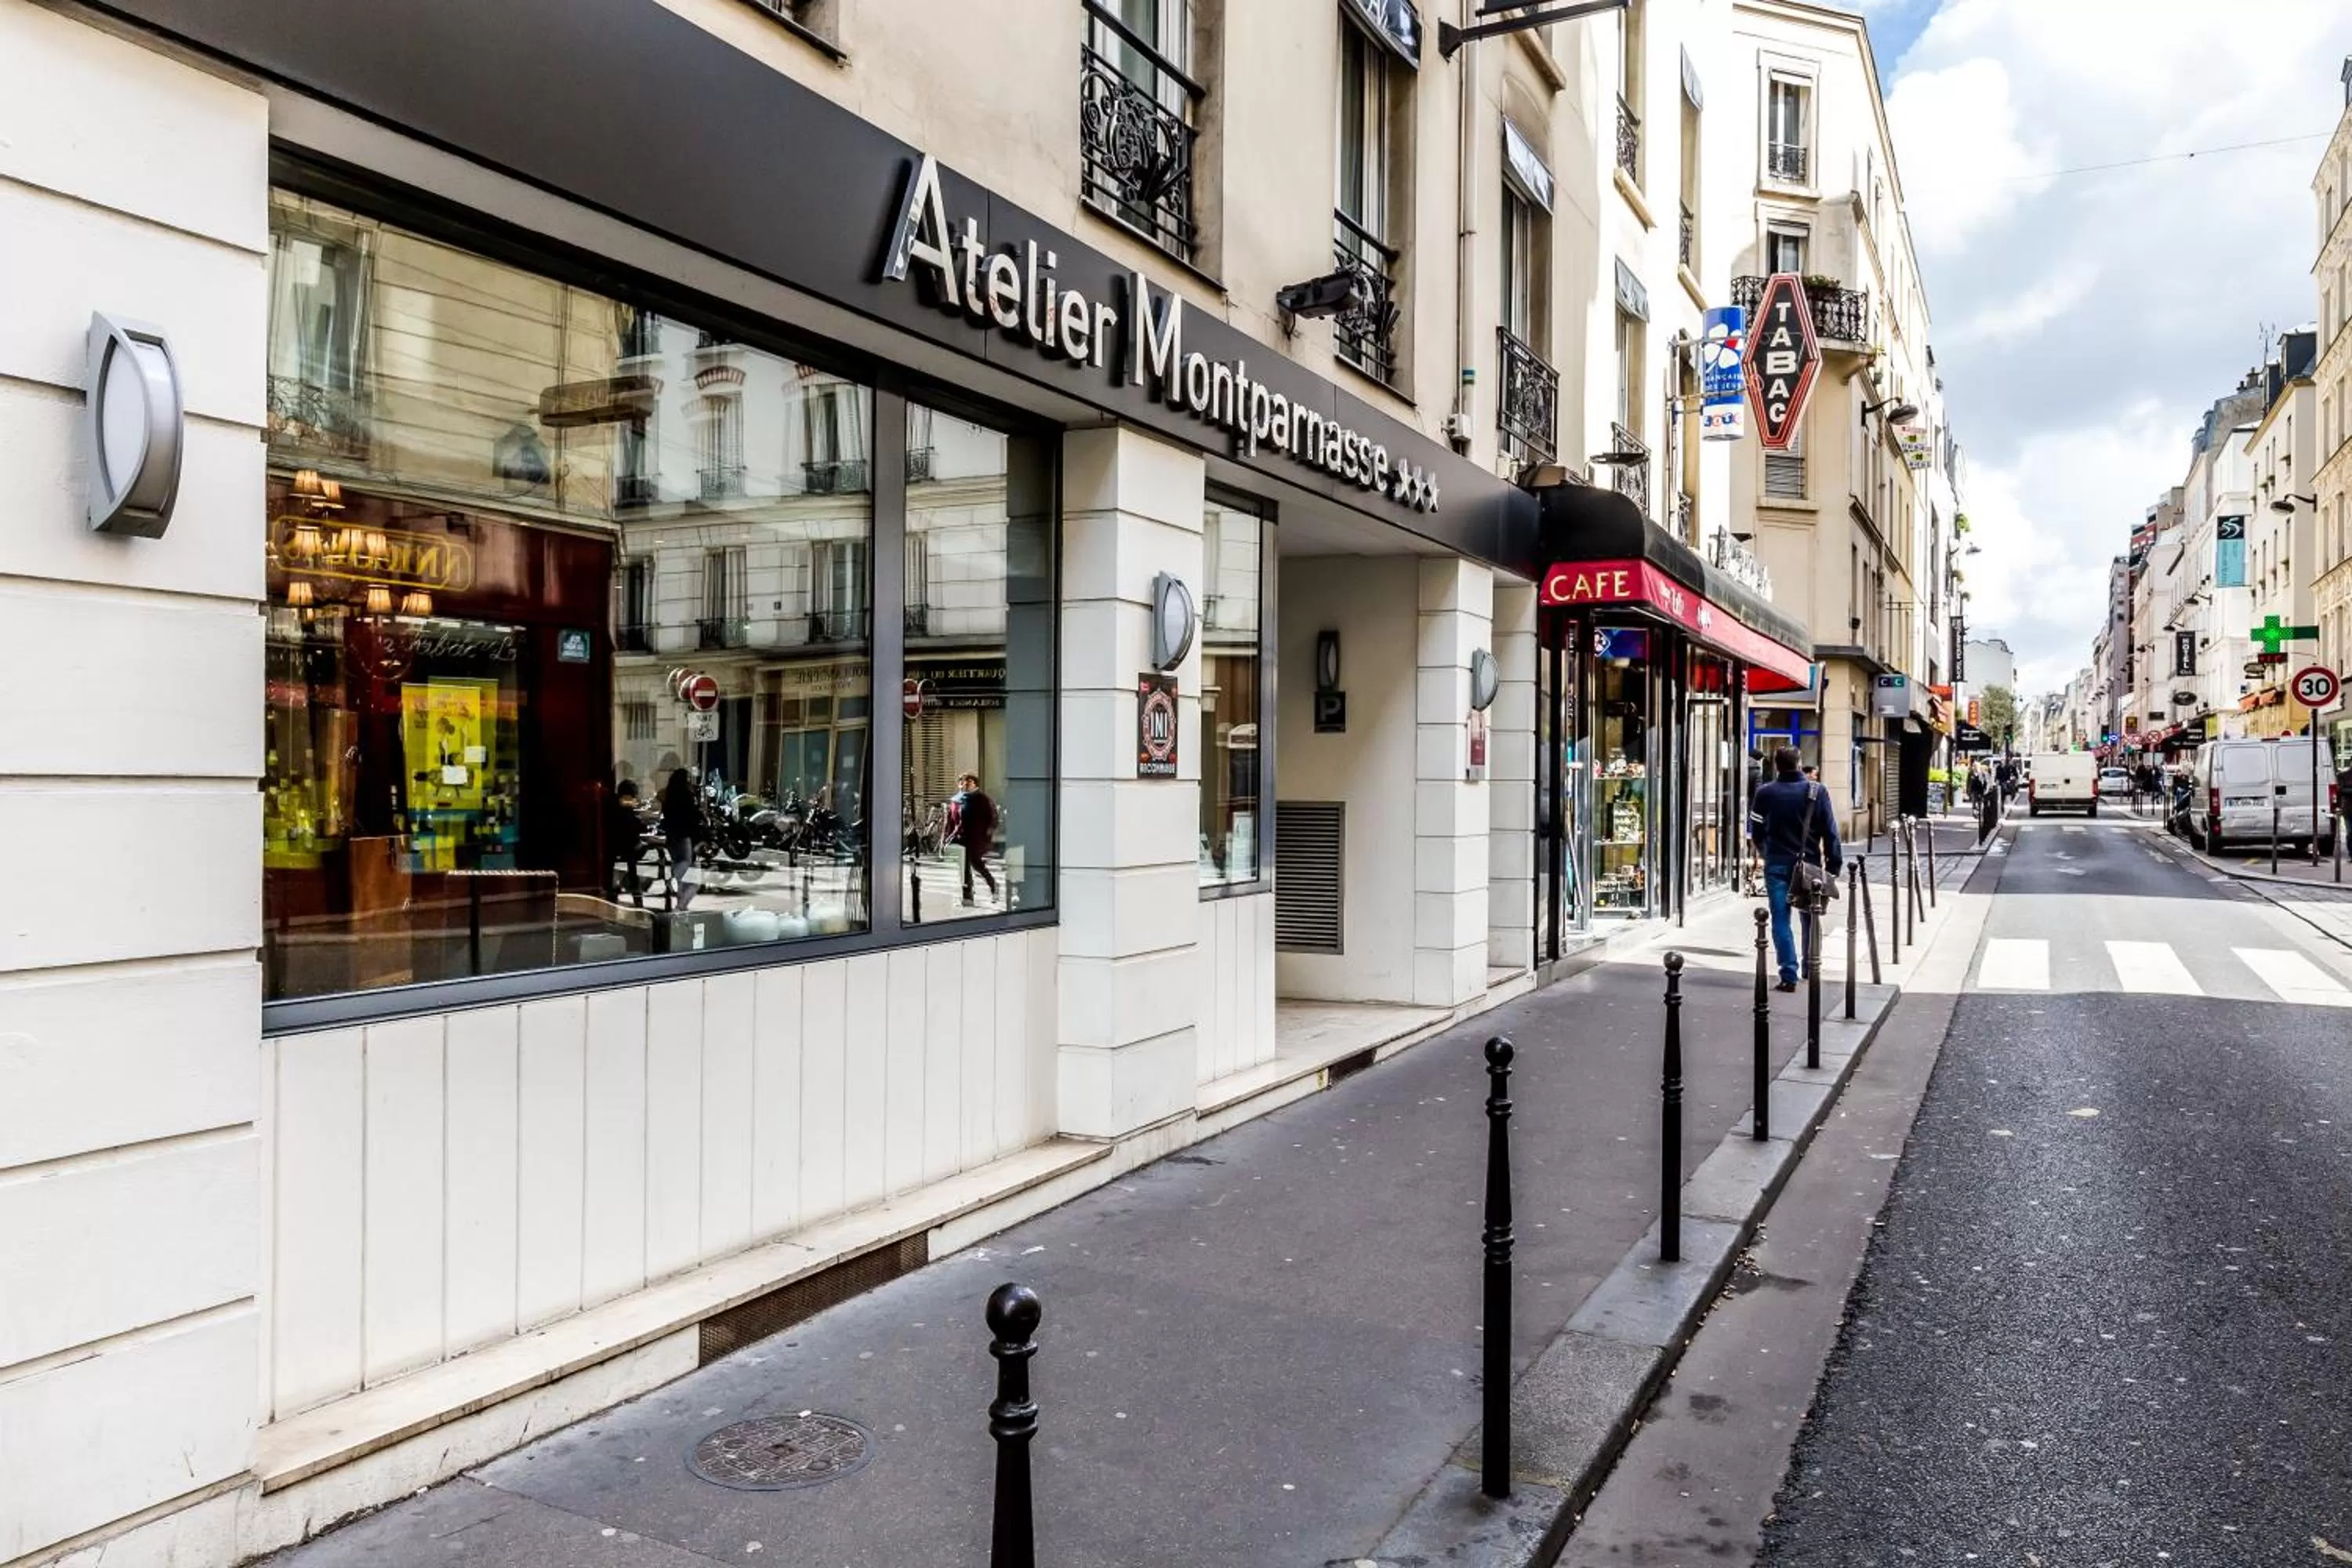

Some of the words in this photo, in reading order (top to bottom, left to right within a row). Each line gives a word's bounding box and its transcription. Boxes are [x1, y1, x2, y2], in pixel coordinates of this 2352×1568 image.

[884, 156, 1117, 368] Atelier
[1129, 271, 1388, 492] Montparnasse
[1766, 302, 1797, 423] TABAC
[1550, 571, 1631, 601] CAFE
[2301, 678, 2331, 696] 30
[1319, 696, 1341, 722] P
